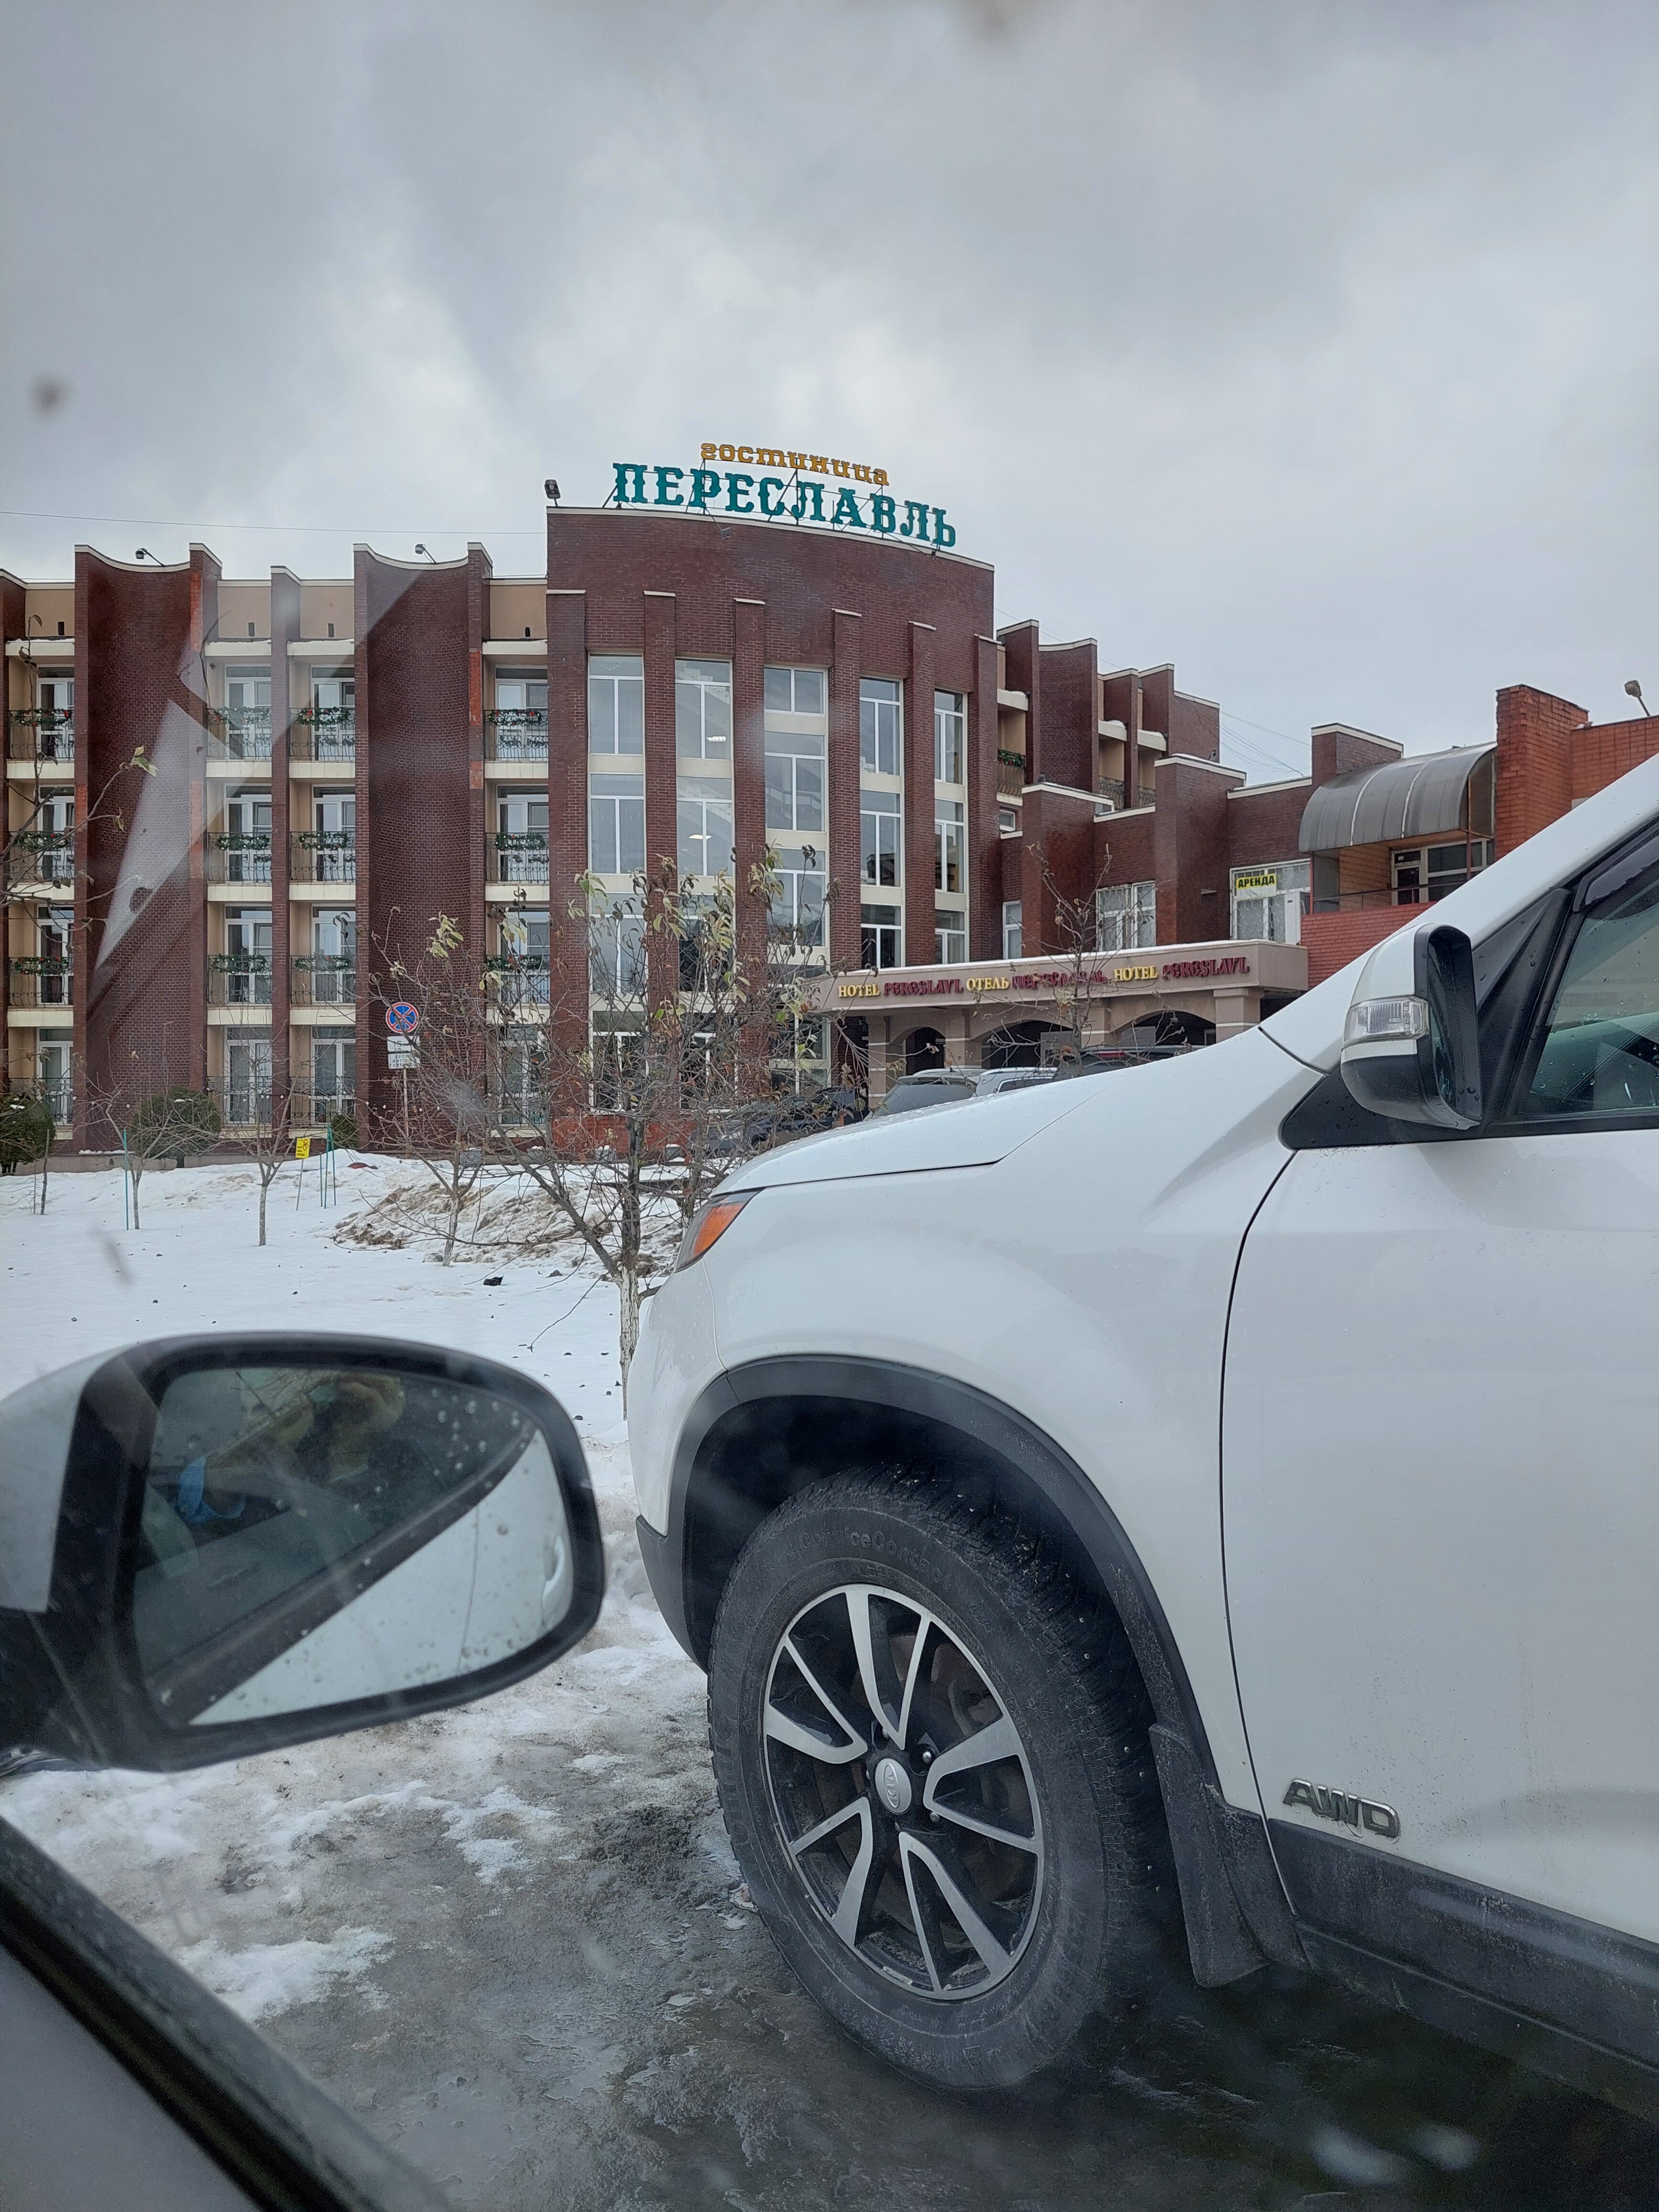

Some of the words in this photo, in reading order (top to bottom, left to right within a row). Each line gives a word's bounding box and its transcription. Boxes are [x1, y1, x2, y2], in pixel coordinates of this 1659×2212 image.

[700, 443, 890, 487] гостиница
[612, 463, 956, 547] ПЕРЕСЛАВЛЬ
[1238, 875, 1275, 888] АРЕНДА
[838, 984, 880, 997] HOTEL
[884, 979, 963, 996] PERESLAVL
[966, 977, 1010, 992] ОТЕЛЬ
[1113, 965, 1158, 982] HOTEL
[1162, 957, 1250, 980] PERESLAVL
[885, 1771, 898, 1802] KIA
[1282, 1779, 1401, 1837] AWD
